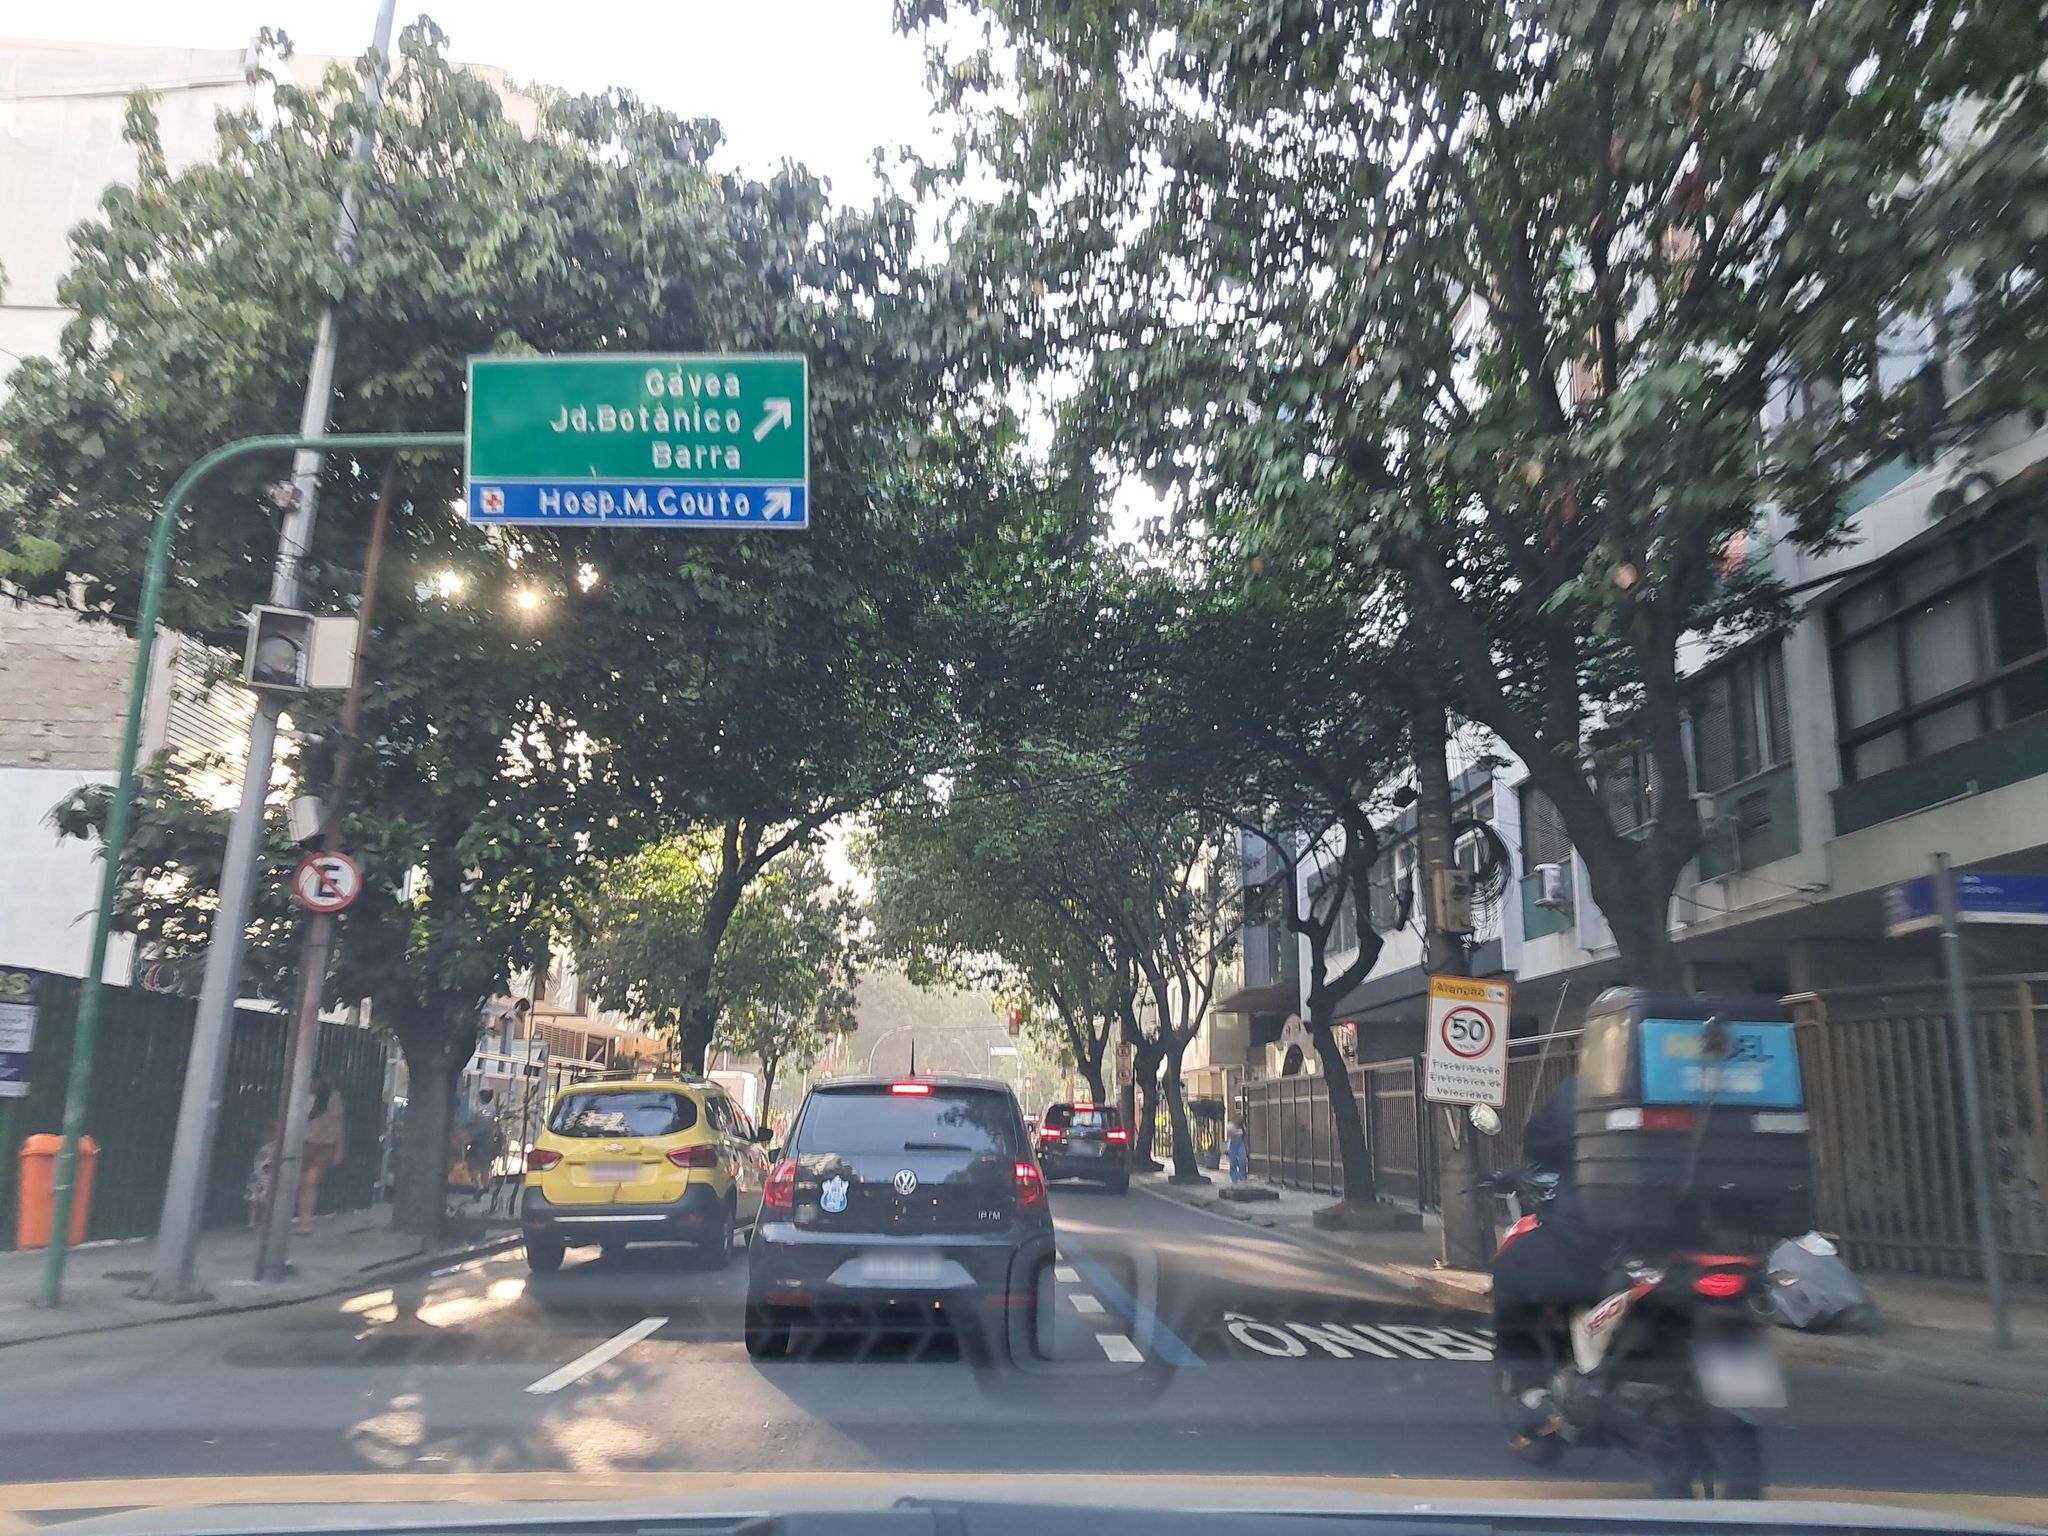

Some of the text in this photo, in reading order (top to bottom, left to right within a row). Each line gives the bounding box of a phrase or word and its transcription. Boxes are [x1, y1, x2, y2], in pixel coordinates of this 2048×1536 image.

[645, 362, 740, 398] Gávea
[652, 440, 741, 470] Barra
[1452, 1018, 1485, 1042] 50
